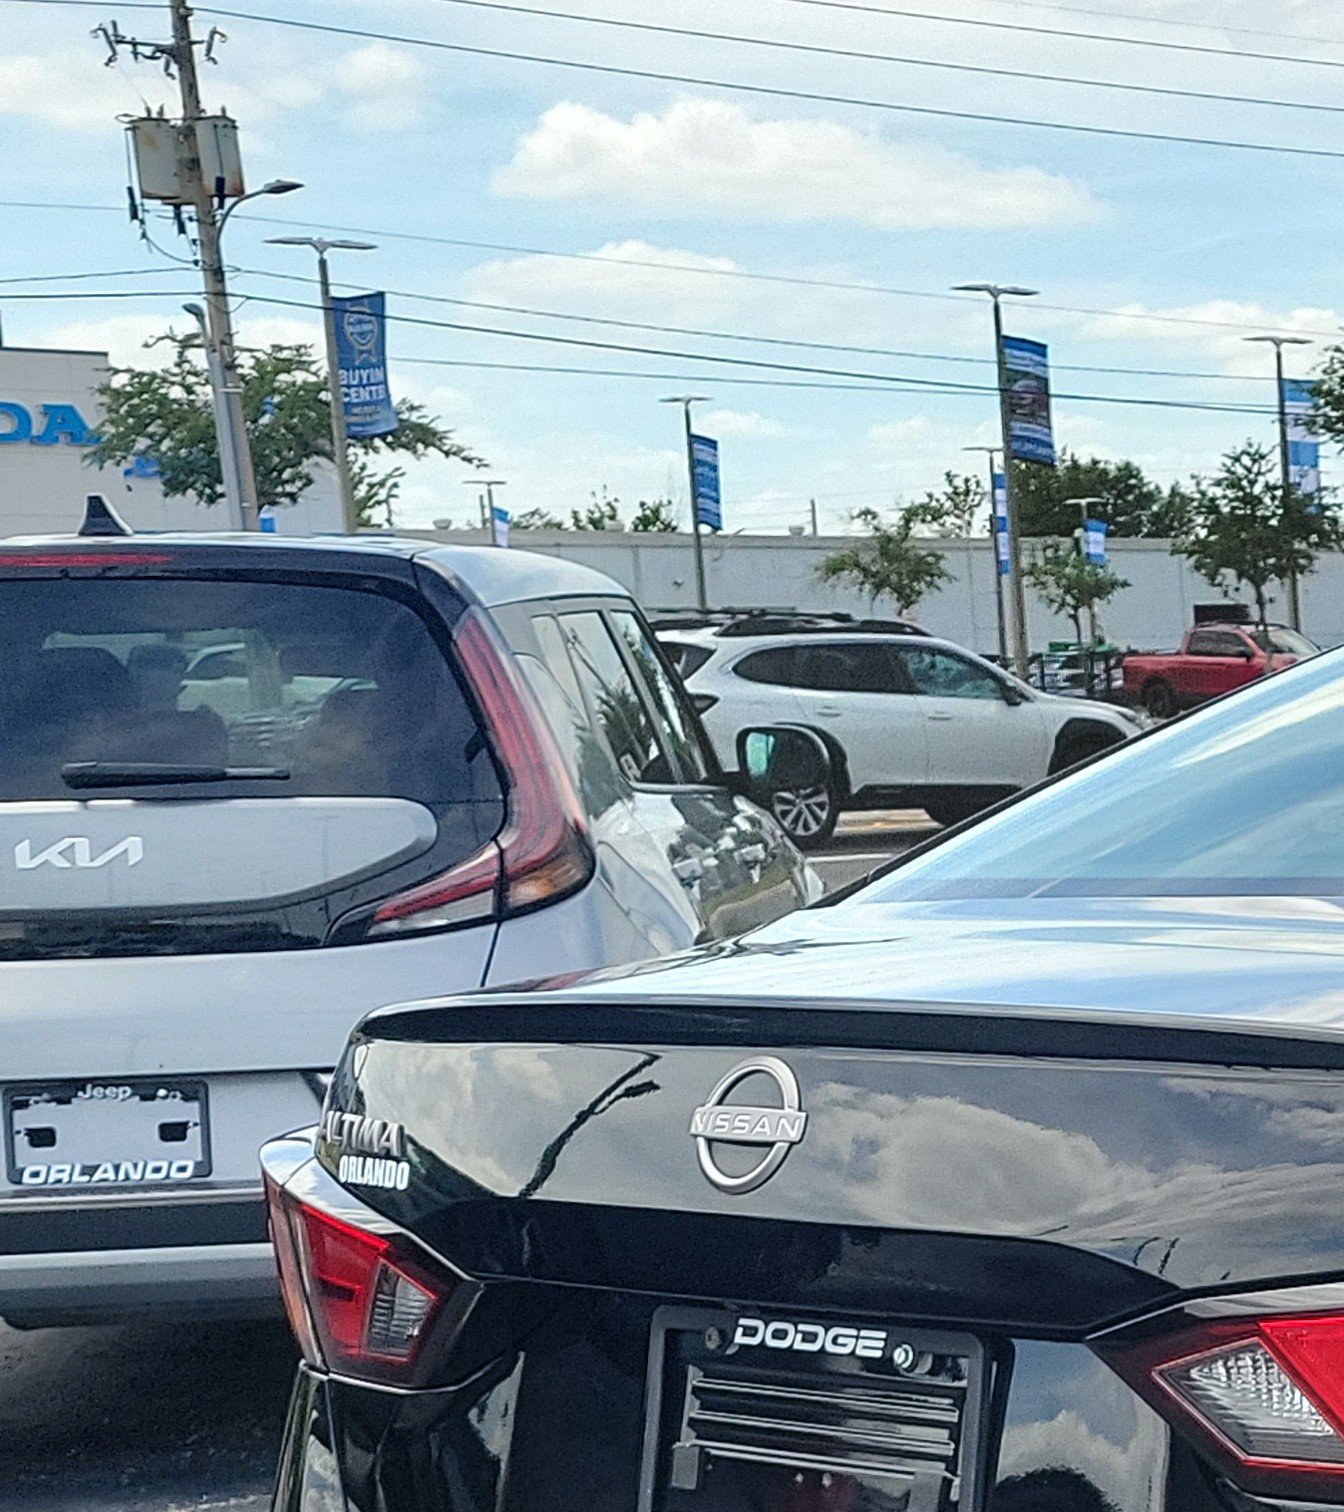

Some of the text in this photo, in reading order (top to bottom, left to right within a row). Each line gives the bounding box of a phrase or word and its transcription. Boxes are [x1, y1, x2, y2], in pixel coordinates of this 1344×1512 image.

[14, 836, 144, 869] KIA
[76, 1083, 132, 1101] Jeep
[320, 1110, 403, 1158] ALTIMA
[690, 1111, 801, 1139] NISSAN
[22, 1159, 195, 1185] ORLANDO
[338, 1154, 410, 1190] ORLANDO
[733, 1317, 888, 1359] DODGE
